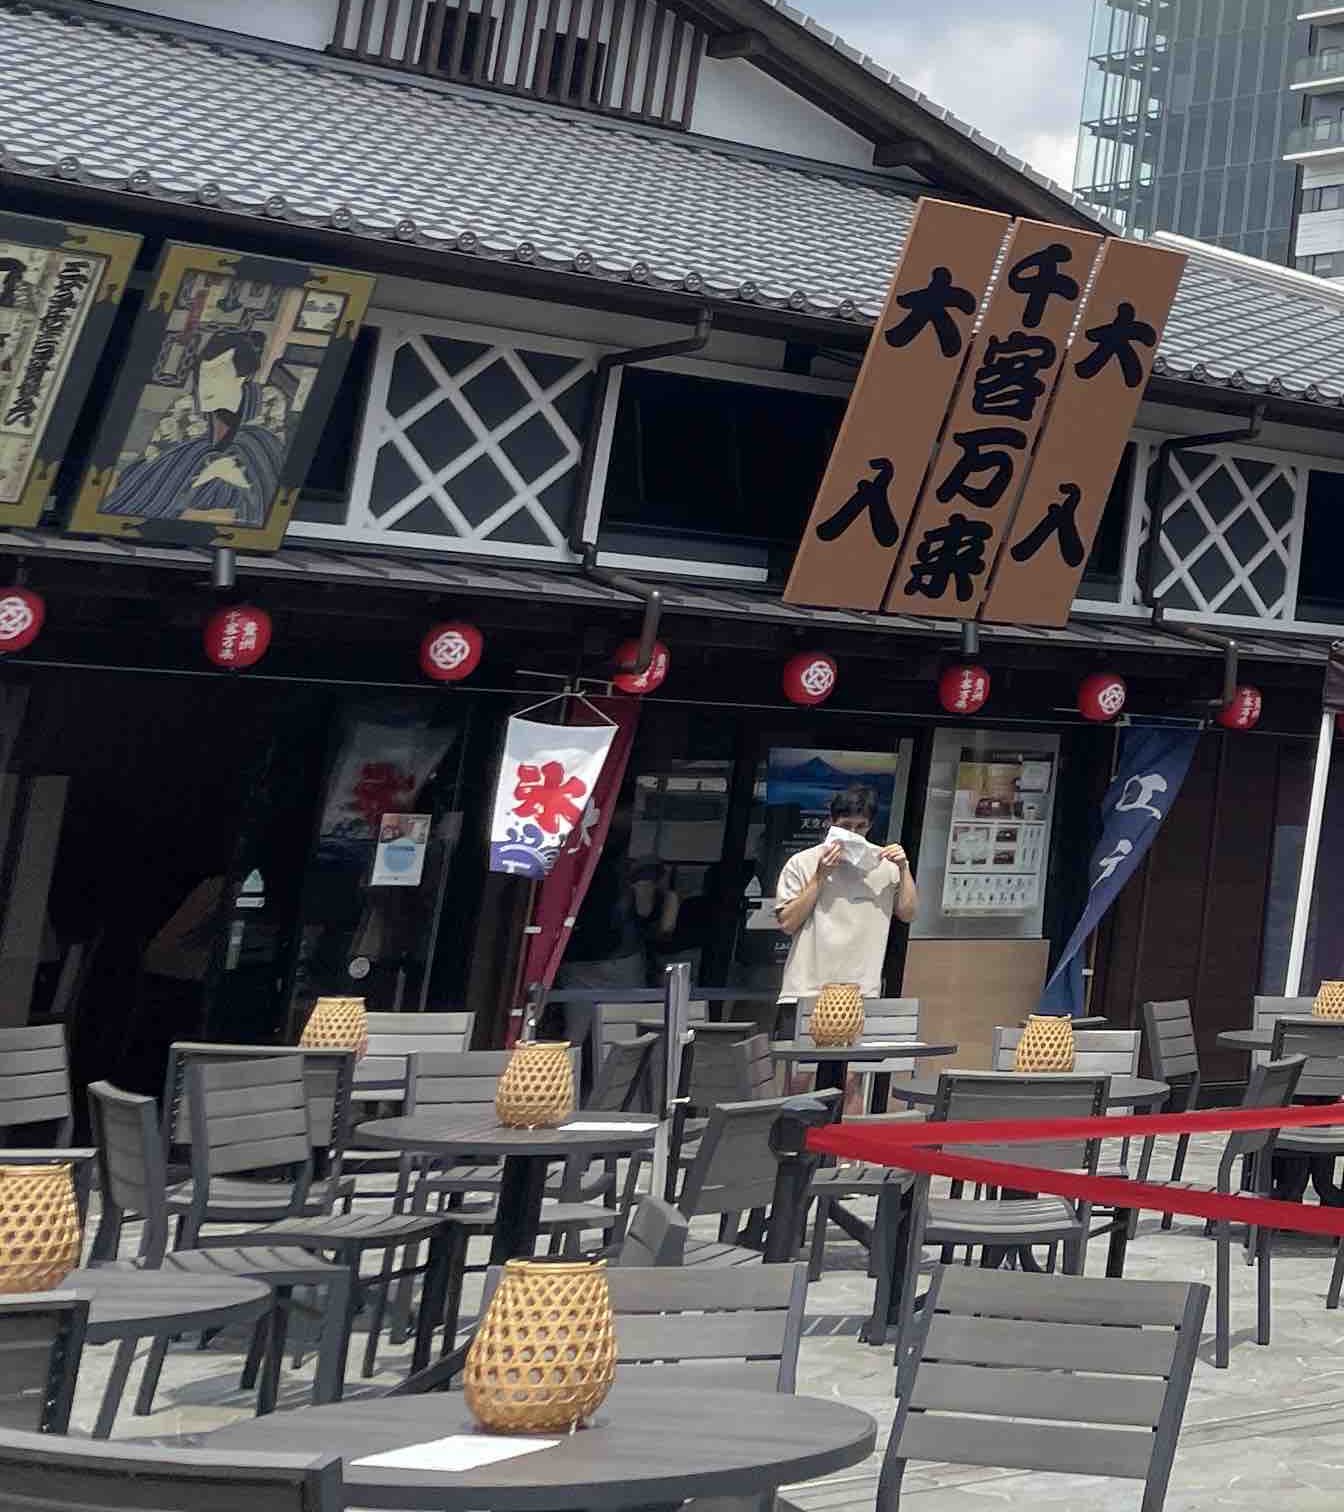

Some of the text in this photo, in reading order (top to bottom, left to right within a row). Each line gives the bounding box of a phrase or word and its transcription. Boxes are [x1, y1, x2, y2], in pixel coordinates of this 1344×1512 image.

[816, 267, 976, 548] 大入
[903, 243, 1079, 602] 千客万来
[1010, 303, 1156, 567] 大入
[512, 761, 586, 834] 氷
